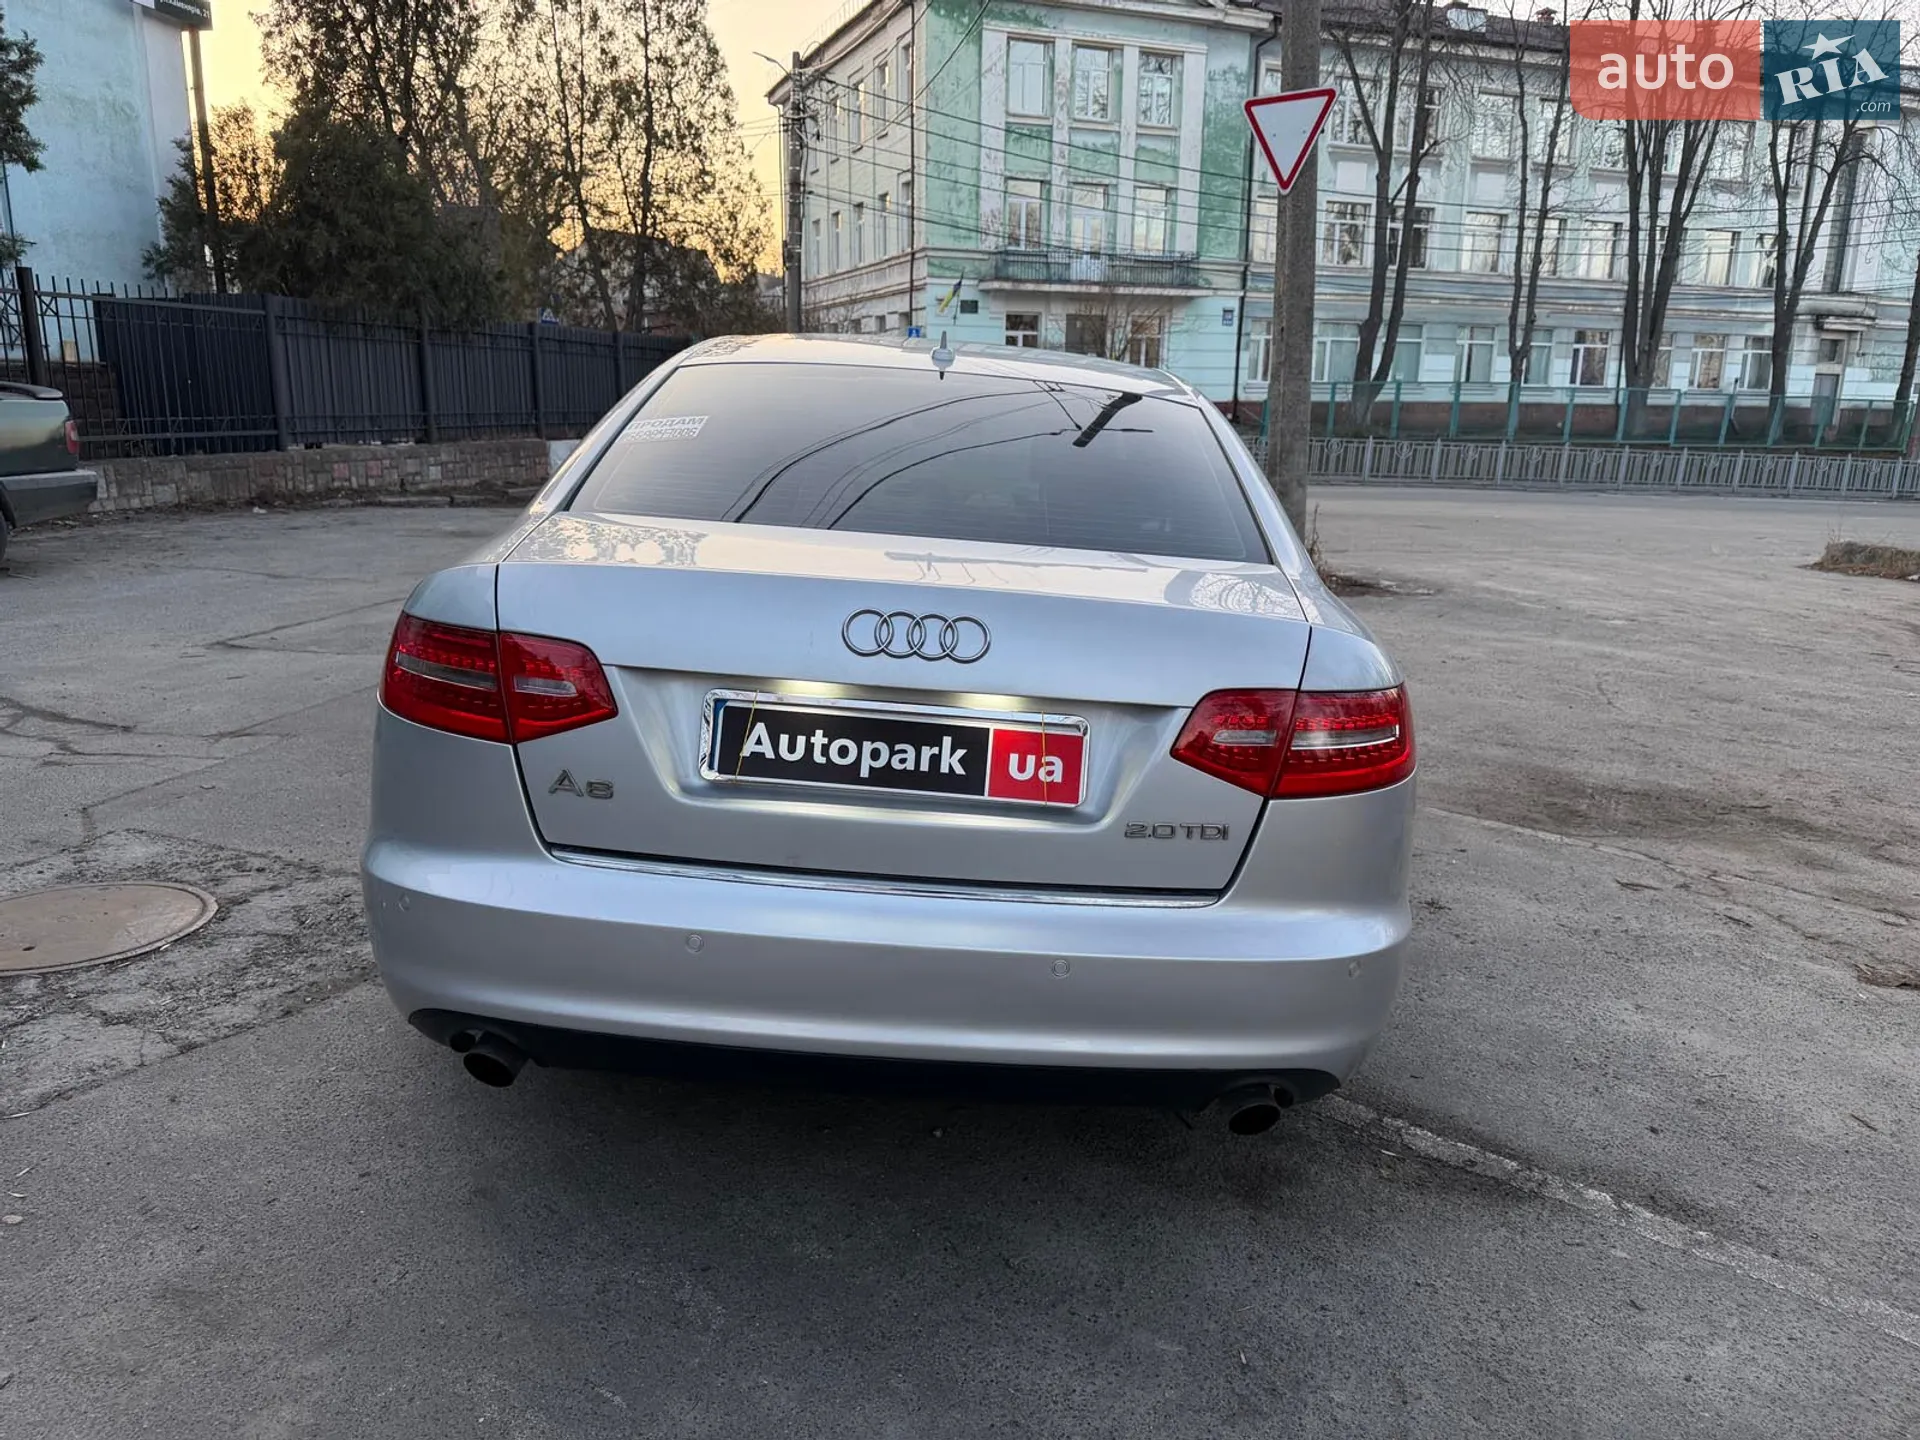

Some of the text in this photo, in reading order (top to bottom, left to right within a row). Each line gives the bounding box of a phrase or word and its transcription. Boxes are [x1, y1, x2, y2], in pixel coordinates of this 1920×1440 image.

[627, 417, 706, 431] ПРОДАМ
[740, 721, 1063, 783] Autopark ua
[547, 768, 614, 800] A6
